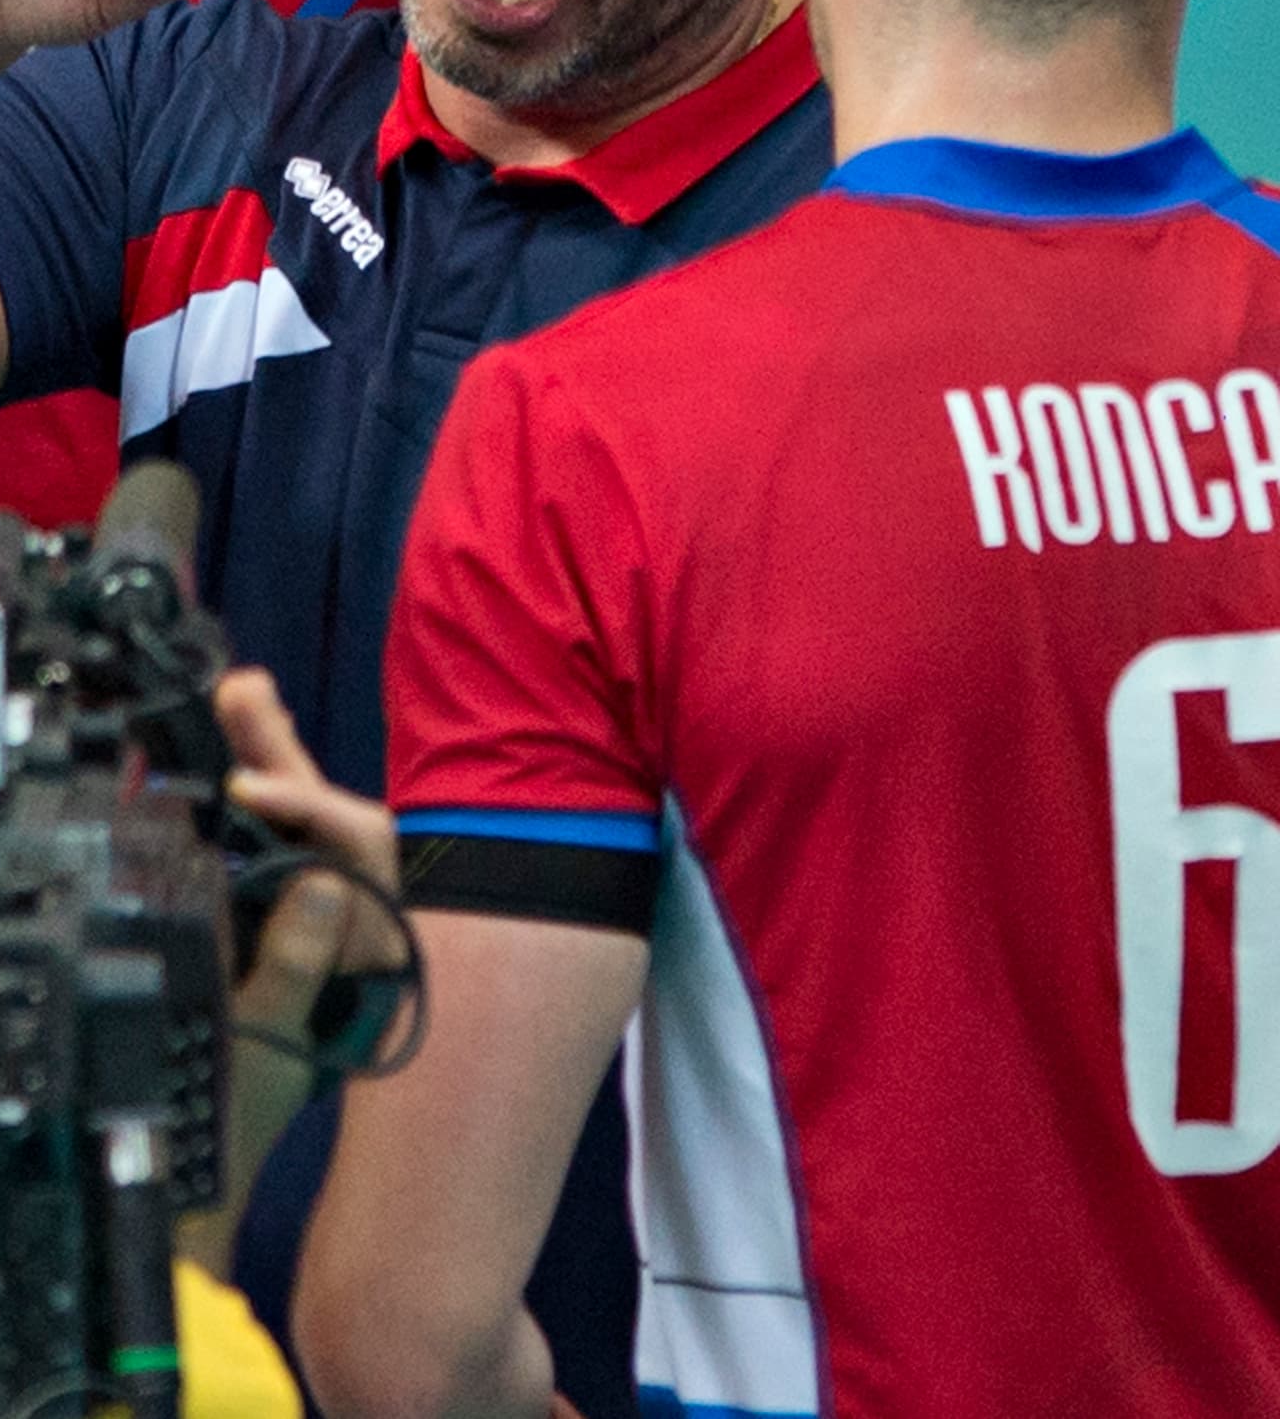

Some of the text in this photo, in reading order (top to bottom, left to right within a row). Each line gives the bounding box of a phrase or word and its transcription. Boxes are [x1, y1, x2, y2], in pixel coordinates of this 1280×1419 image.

[310, 187, 385, 270] errea
[944, 369, 1280, 554] KONCA
[1108, 630, 1280, 1176] 6
